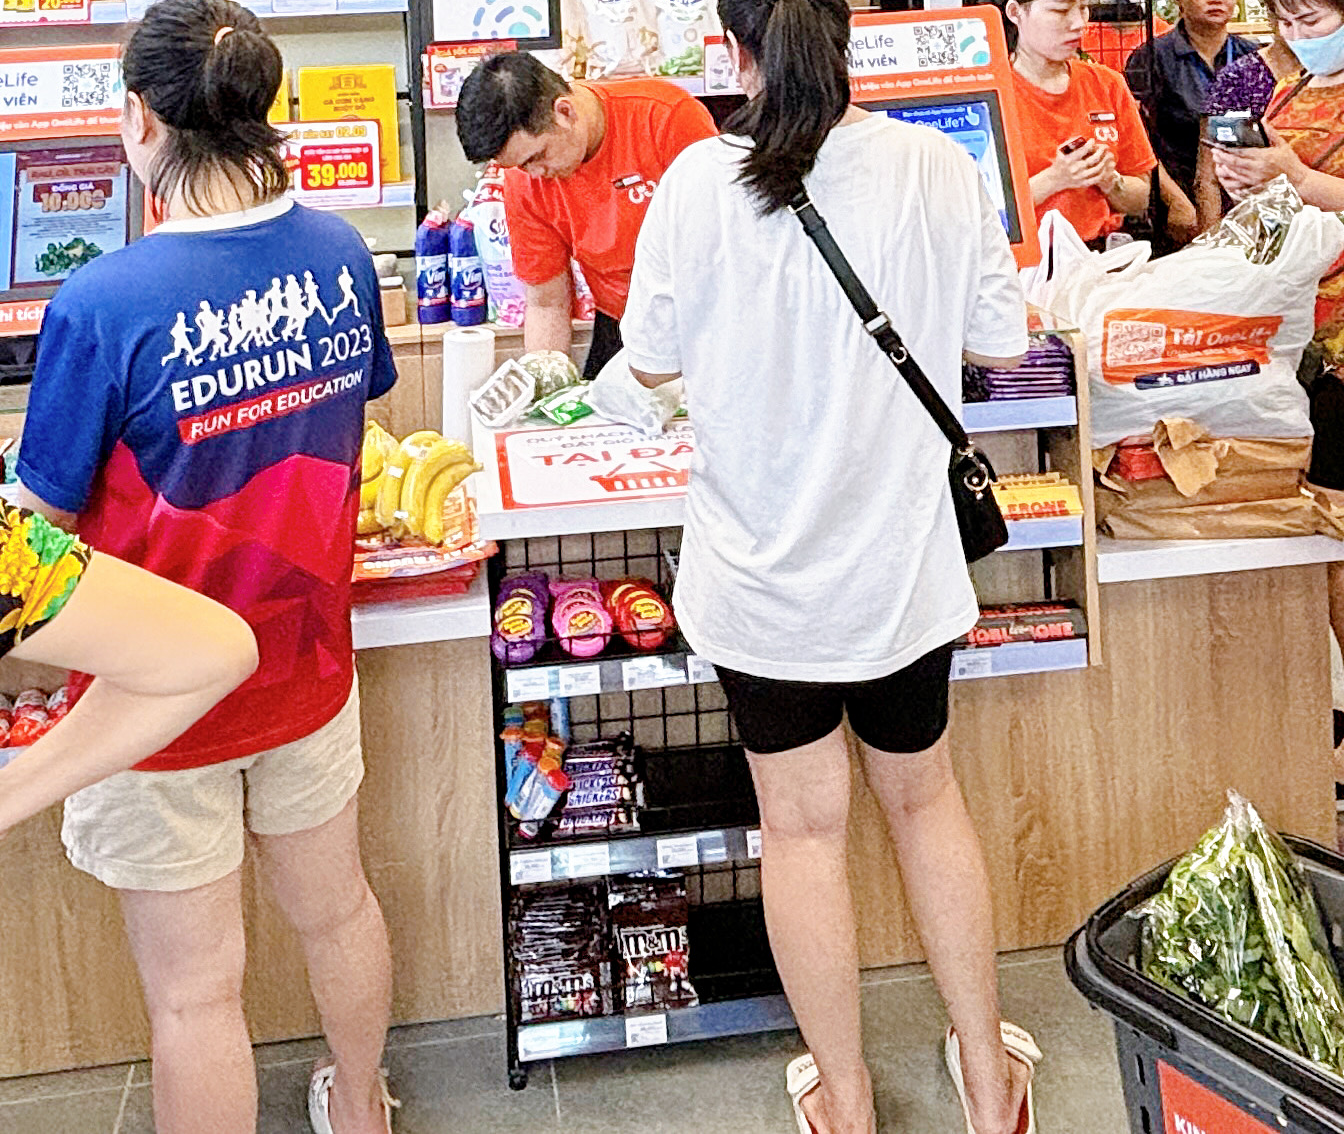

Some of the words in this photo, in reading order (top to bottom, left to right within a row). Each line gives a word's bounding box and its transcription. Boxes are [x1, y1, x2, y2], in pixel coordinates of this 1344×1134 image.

[848, 35, 894, 50] neLife
[867, 56, 898, 67] VIÊN
[4, 95, 38, 107] VIÊN
[307, 161, 368, 188] 39.000
[170, 342, 313, 414] EDURUN
[318, 324, 373, 367] 2023
[1228, 363, 1252, 377] NGAY
[190, 409, 232, 440] RUN
[236, 397, 273, 427] FOR
[276, 368, 364, 412] EDUCATION
[531, 451, 612, 467] TẠI
[627, 441, 695, 459] ĐÂ
[1006, 500, 1068, 515] ERONE
[568, 788, 620, 807] SNICKERS
